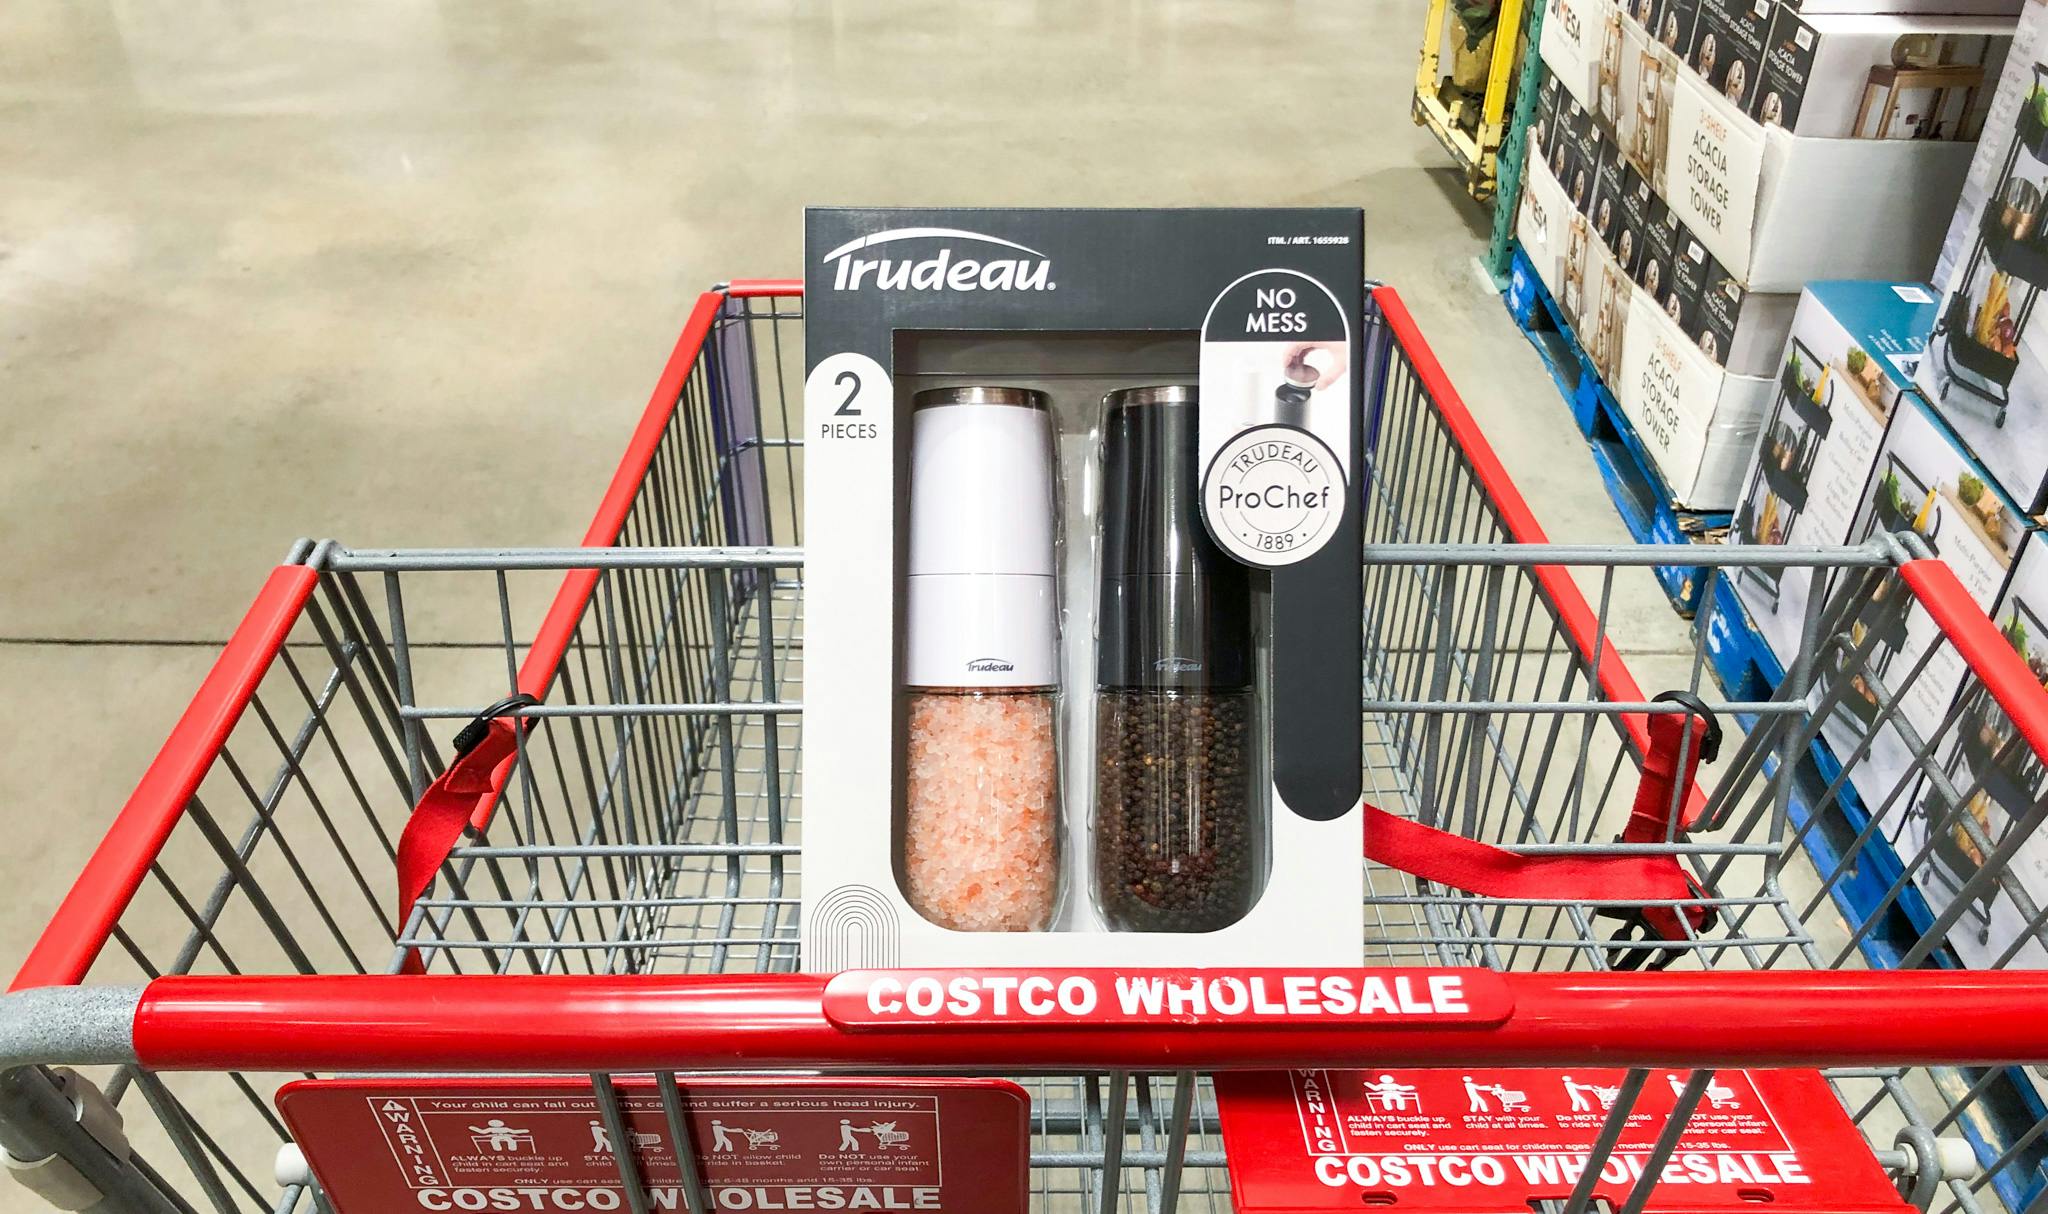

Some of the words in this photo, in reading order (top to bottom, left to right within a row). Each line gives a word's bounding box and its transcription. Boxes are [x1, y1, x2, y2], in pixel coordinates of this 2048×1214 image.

[1692, 130, 1727, 176] ACACIA
[1688, 154, 1729, 210] STORAGE
[1690, 186, 1722, 234] TOWER
[1292, 236, 1311, 244] ART.
[1256, 288, 1296, 309] NO
[1246, 312, 1308, 332] MESS
[834, 370, 862, 416] 2
[1648, 352, 1680, 404] ACACIA
[1642, 372, 1680, 434] STORAGE
[822, 424, 877, 439] PIECES
[1642, 400, 1670, 454] TOWER
[1231, 444, 1318, 474] TRUDEAU
[1220, 485, 1330, 508] ProChef
[1256, 534, 1294, 550] 1889
[966, 658, 1014, 672] Trudeau
[867, 976, 1098, 1016] COSTCO
[1115, 975, 1470, 1016] WHOLESALE
[874, 1101, 920, 1109] injury.
[385, 1112, 438, 1185] WARNING
[1314, 1156, 1504, 1186] COSTCO
[417, 1188, 620, 1210] COSTCO
